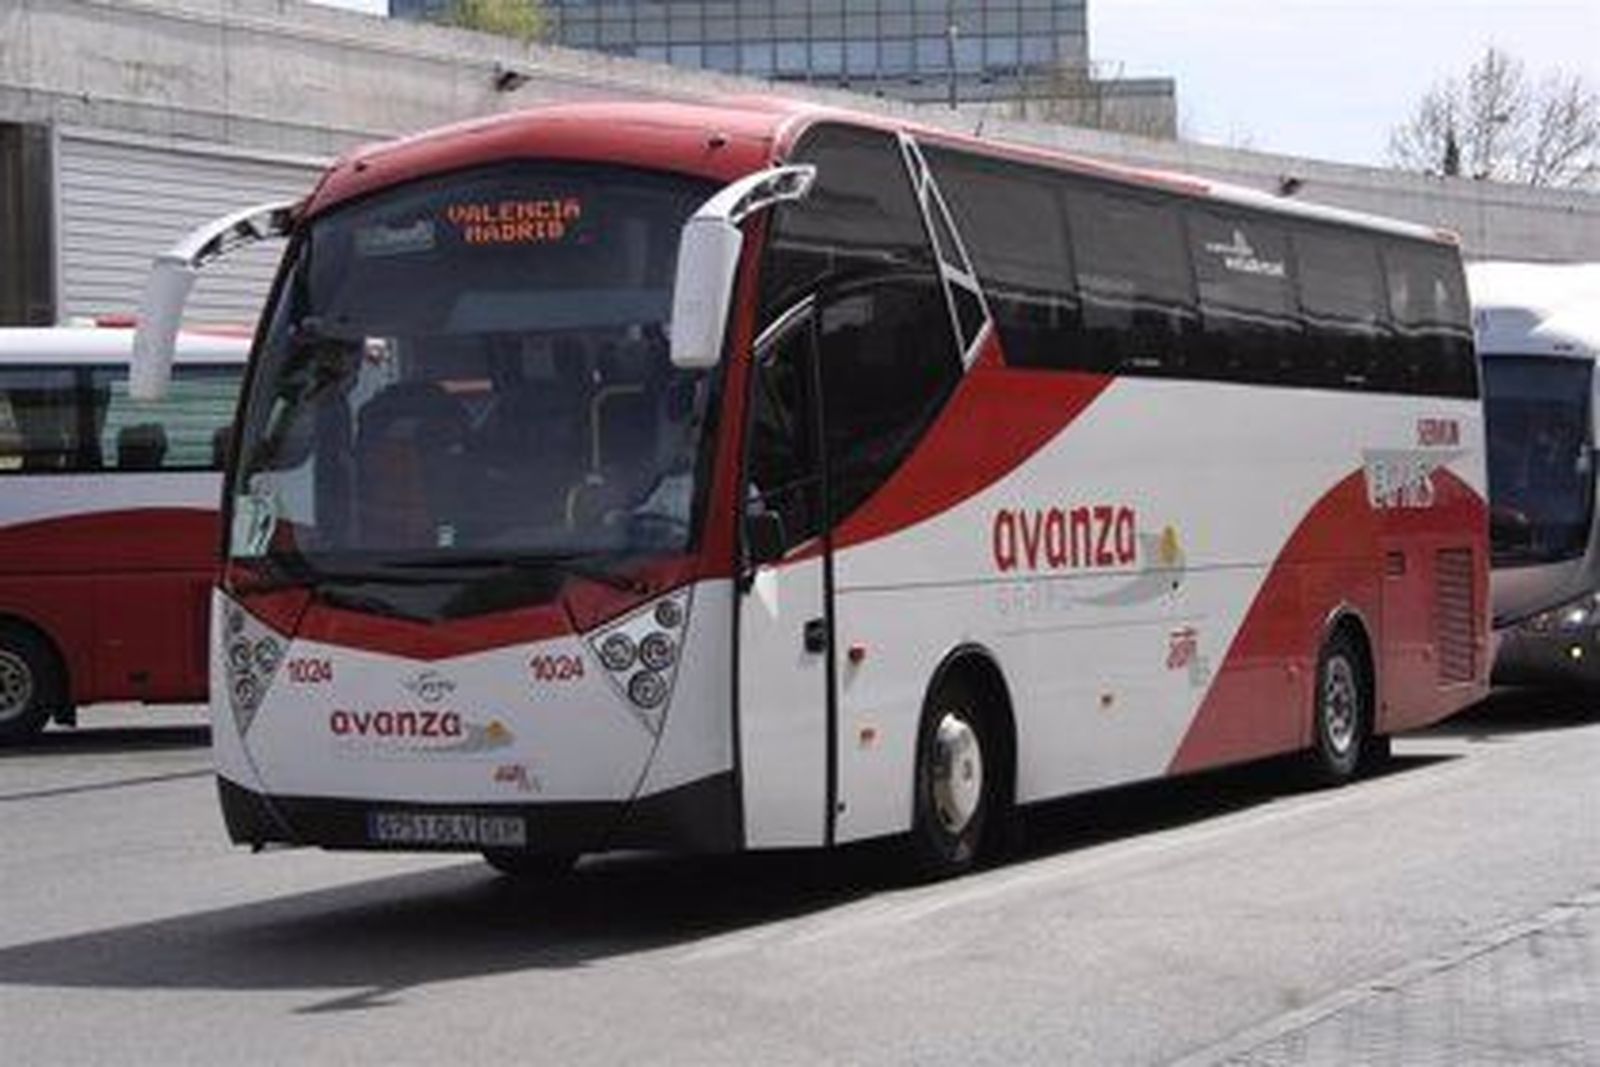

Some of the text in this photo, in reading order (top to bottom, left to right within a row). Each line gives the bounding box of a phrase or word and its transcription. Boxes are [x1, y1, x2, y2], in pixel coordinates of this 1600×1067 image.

[449, 199, 582, 223] VALENCIA
[464, 221, 565, 243] MADRID
[993, 505, 1136, 572] avanza
[287, 659, 333, 684] 1024
[529, 655, 585, 681] 1024
[330, 709, 462, 737] avanza
